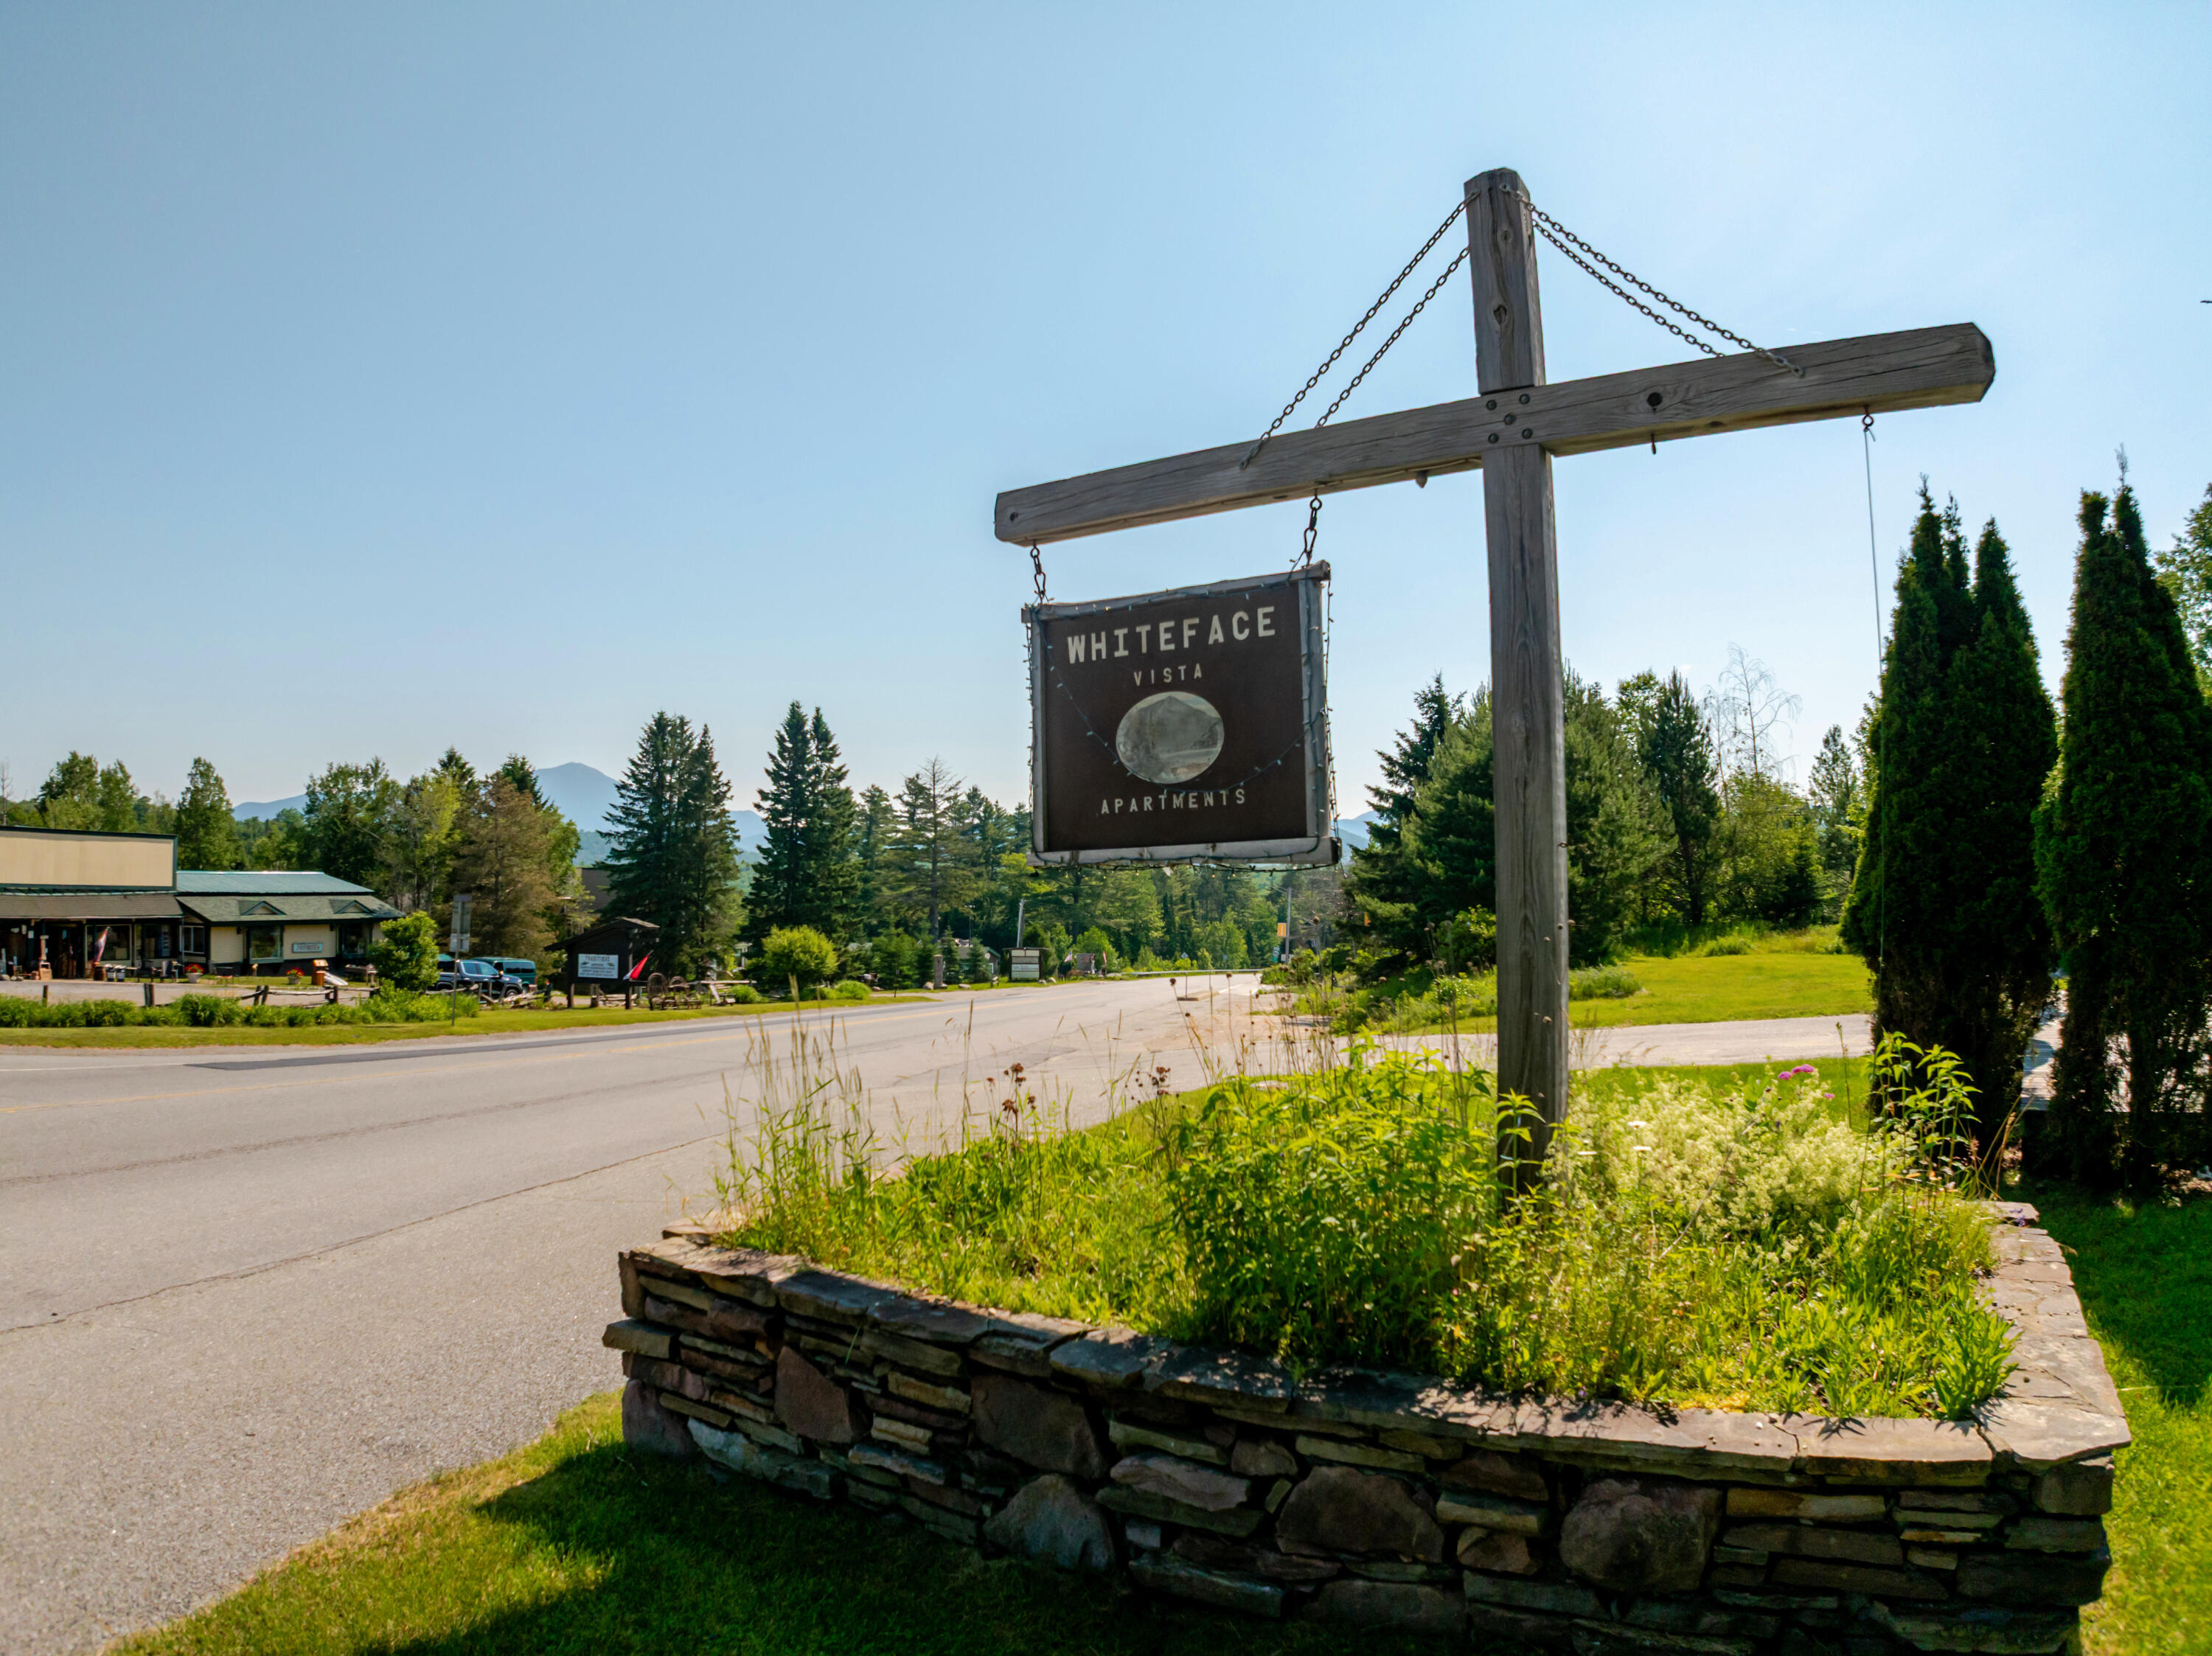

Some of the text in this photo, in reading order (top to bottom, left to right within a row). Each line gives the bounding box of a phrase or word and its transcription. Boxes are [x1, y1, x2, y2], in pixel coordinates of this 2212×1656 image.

[1068, 606, 1276, 664] WHITEFACE
[1133, 663, 1203, 686] VISTA
[1101, 788, 1246, 815] APARTMENTS
